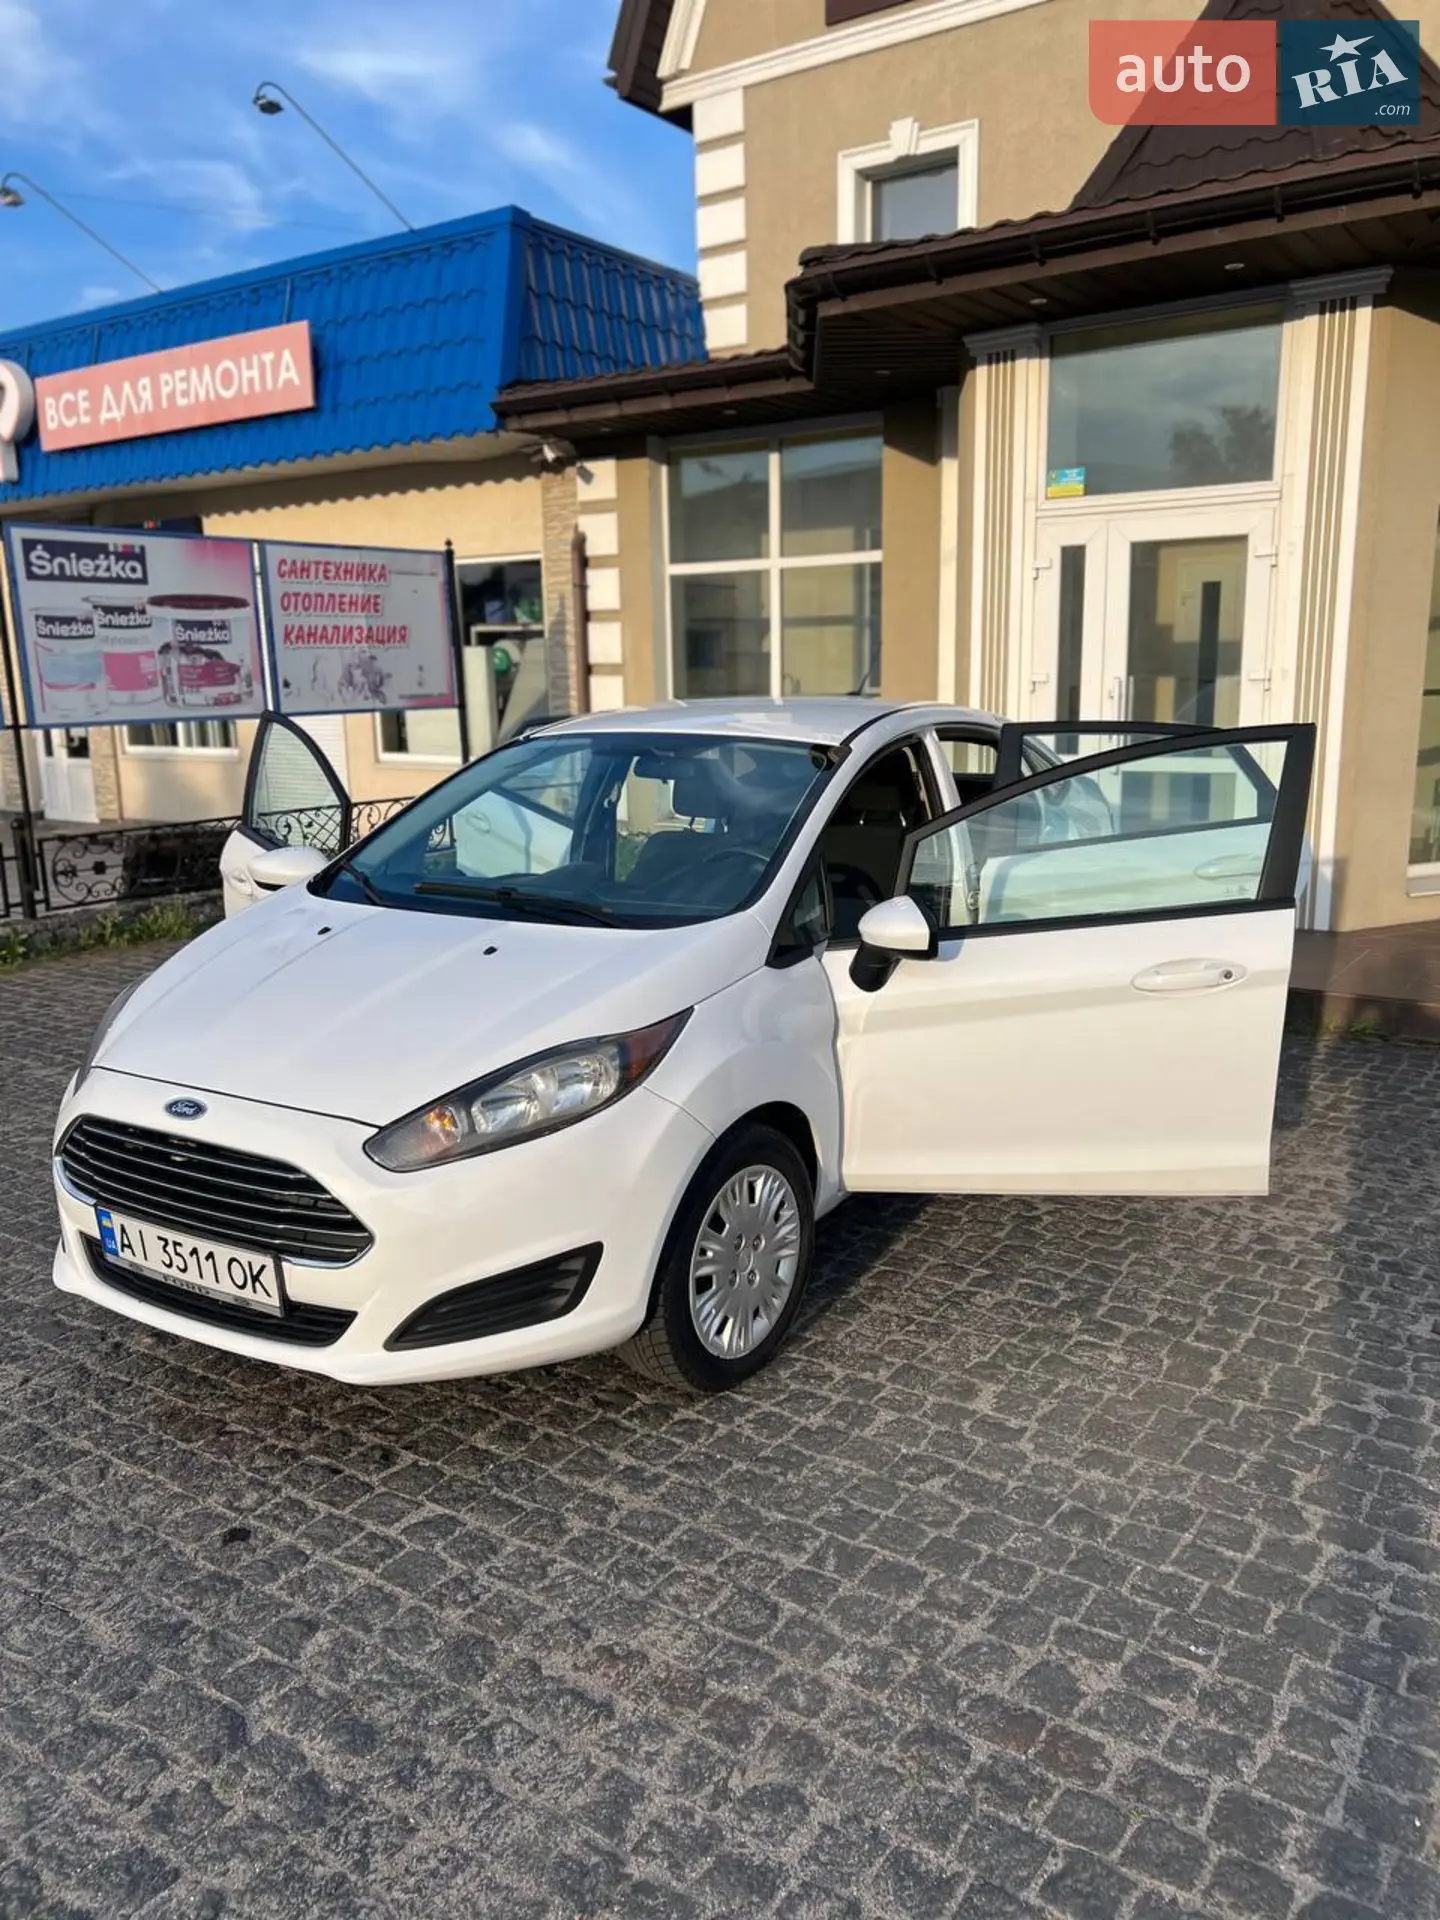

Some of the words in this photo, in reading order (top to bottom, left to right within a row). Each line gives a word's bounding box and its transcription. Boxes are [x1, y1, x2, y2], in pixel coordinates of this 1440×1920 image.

[44, 388, 91, 431] ВСЕ
[99, 376, 153, 425] ДЛЯ
[159, 348, 300, 409] РЕМОНТА
[29, 544, 144, 580] Śnieżka
[277, 557, 388, 583] САНТЕХНИКА
[280, 591, 382, 613] ОТОПЛЕНИЕ
[283, 624, 409, 645] КАНАЛИЗАЦИЯ
[157, 1235, 220, 1284] 3511
[227, 1257, 272, 1298] OK
